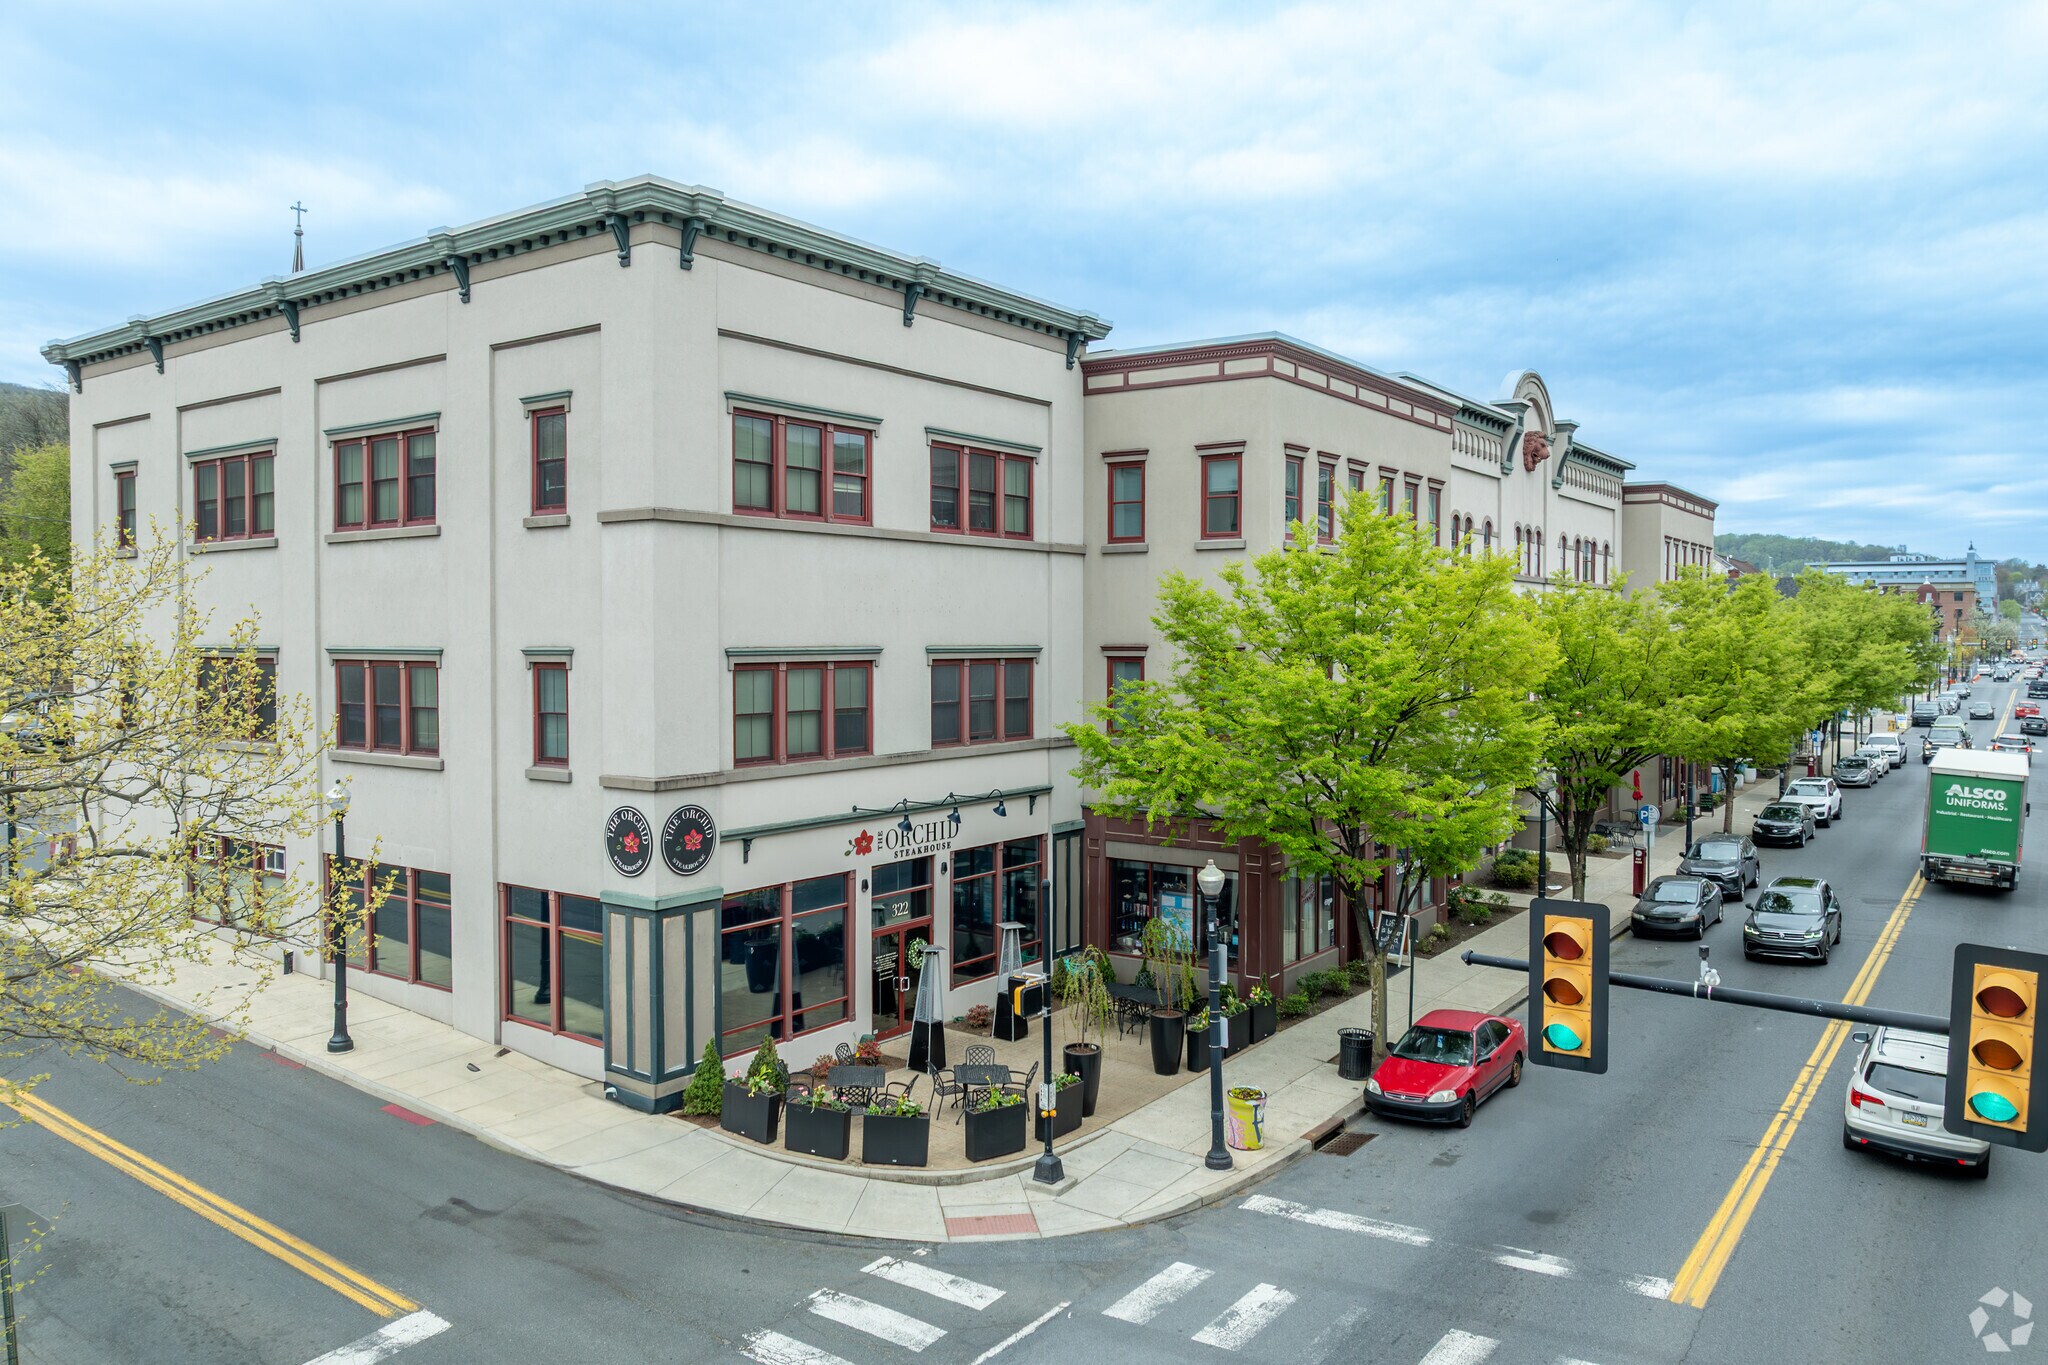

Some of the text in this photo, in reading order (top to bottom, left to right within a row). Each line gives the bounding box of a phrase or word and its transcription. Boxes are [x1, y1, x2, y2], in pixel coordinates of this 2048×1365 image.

[1944, 784, 2007, 801] ALSCO
[1946, 797, 2005, 811] UNIFORMS
[1641, 810, 1648, 819] P
[607, 810, 649, 845] THE ORCHID
[664, 809, 713, 842] THE ORCHID
[885, 820, 959, 850] ORCHID
[893, 841, 952, 859] STEAKHOUSE
[1980, 848, 2010, 856] Alsco.com
[613, 855, 643, 872] STEAKHOUSE
[672, 853, 706, 870] STEAKHOUSE
[891, 901, 909, 918] 322
